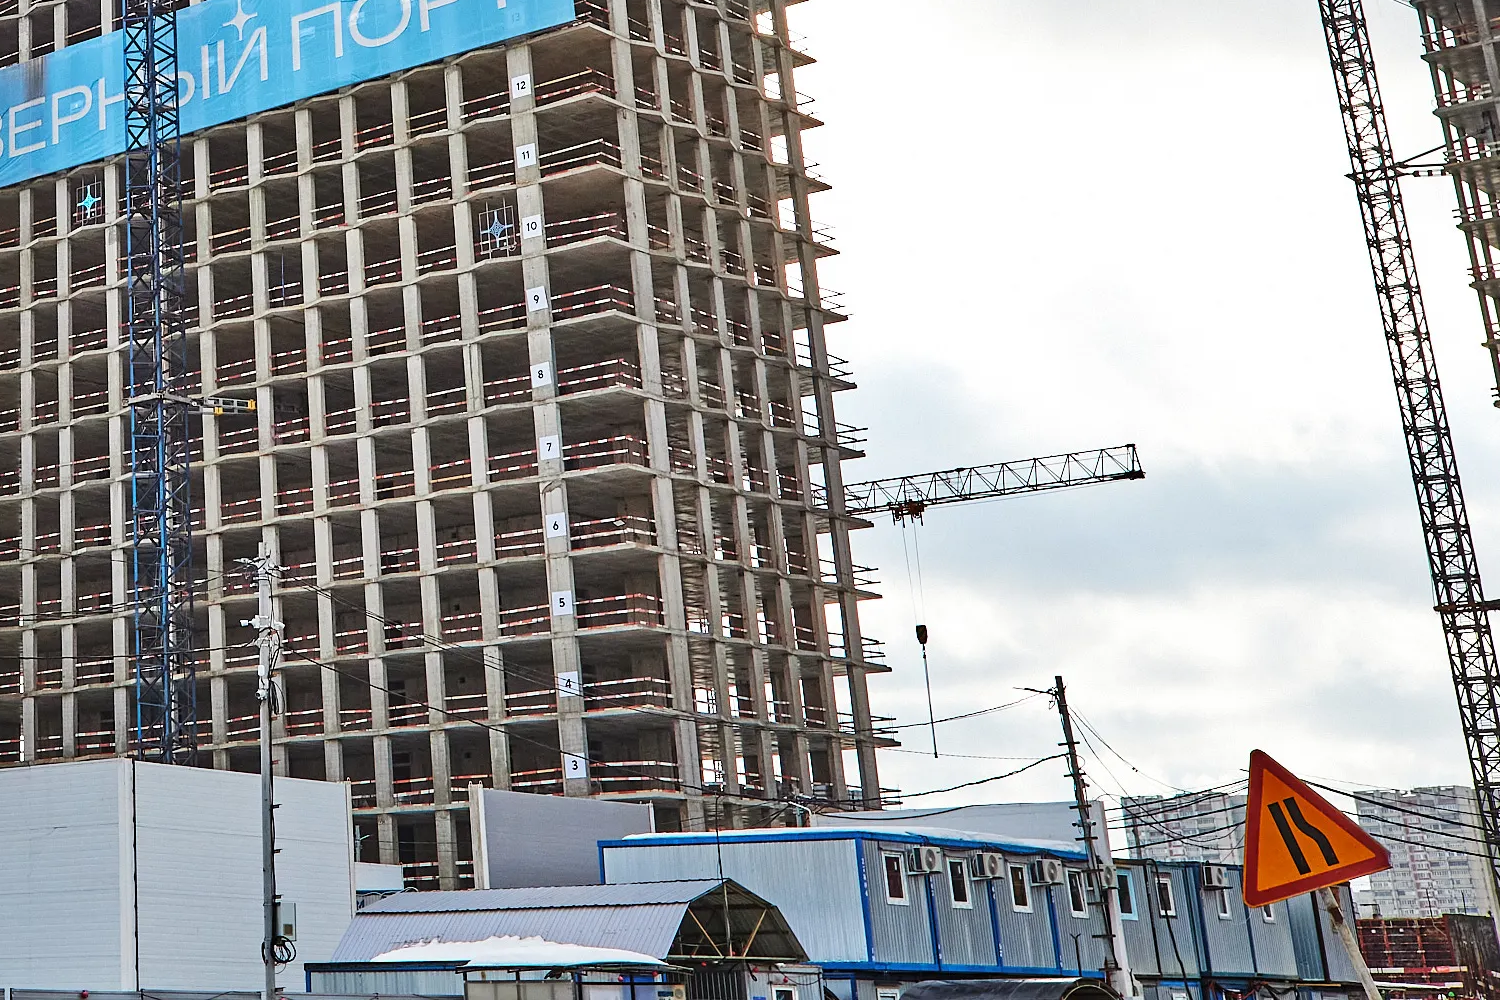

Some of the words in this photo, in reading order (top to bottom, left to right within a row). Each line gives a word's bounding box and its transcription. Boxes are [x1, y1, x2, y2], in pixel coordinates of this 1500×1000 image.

[516, 80, 527, 91] 12
[521, 150, 530, 160] 11
[526, 220, 538, 232] 10
[533, 294, 540, 304] 9
[537, 369, 544, 379] 8
[546, 442, 552, 452] 7
[552, 520, 559, 531] 6
[559, 597, 565, 607] 5
[564, 678, 572, 689] 4
[571, 759, 578, 770] 3
